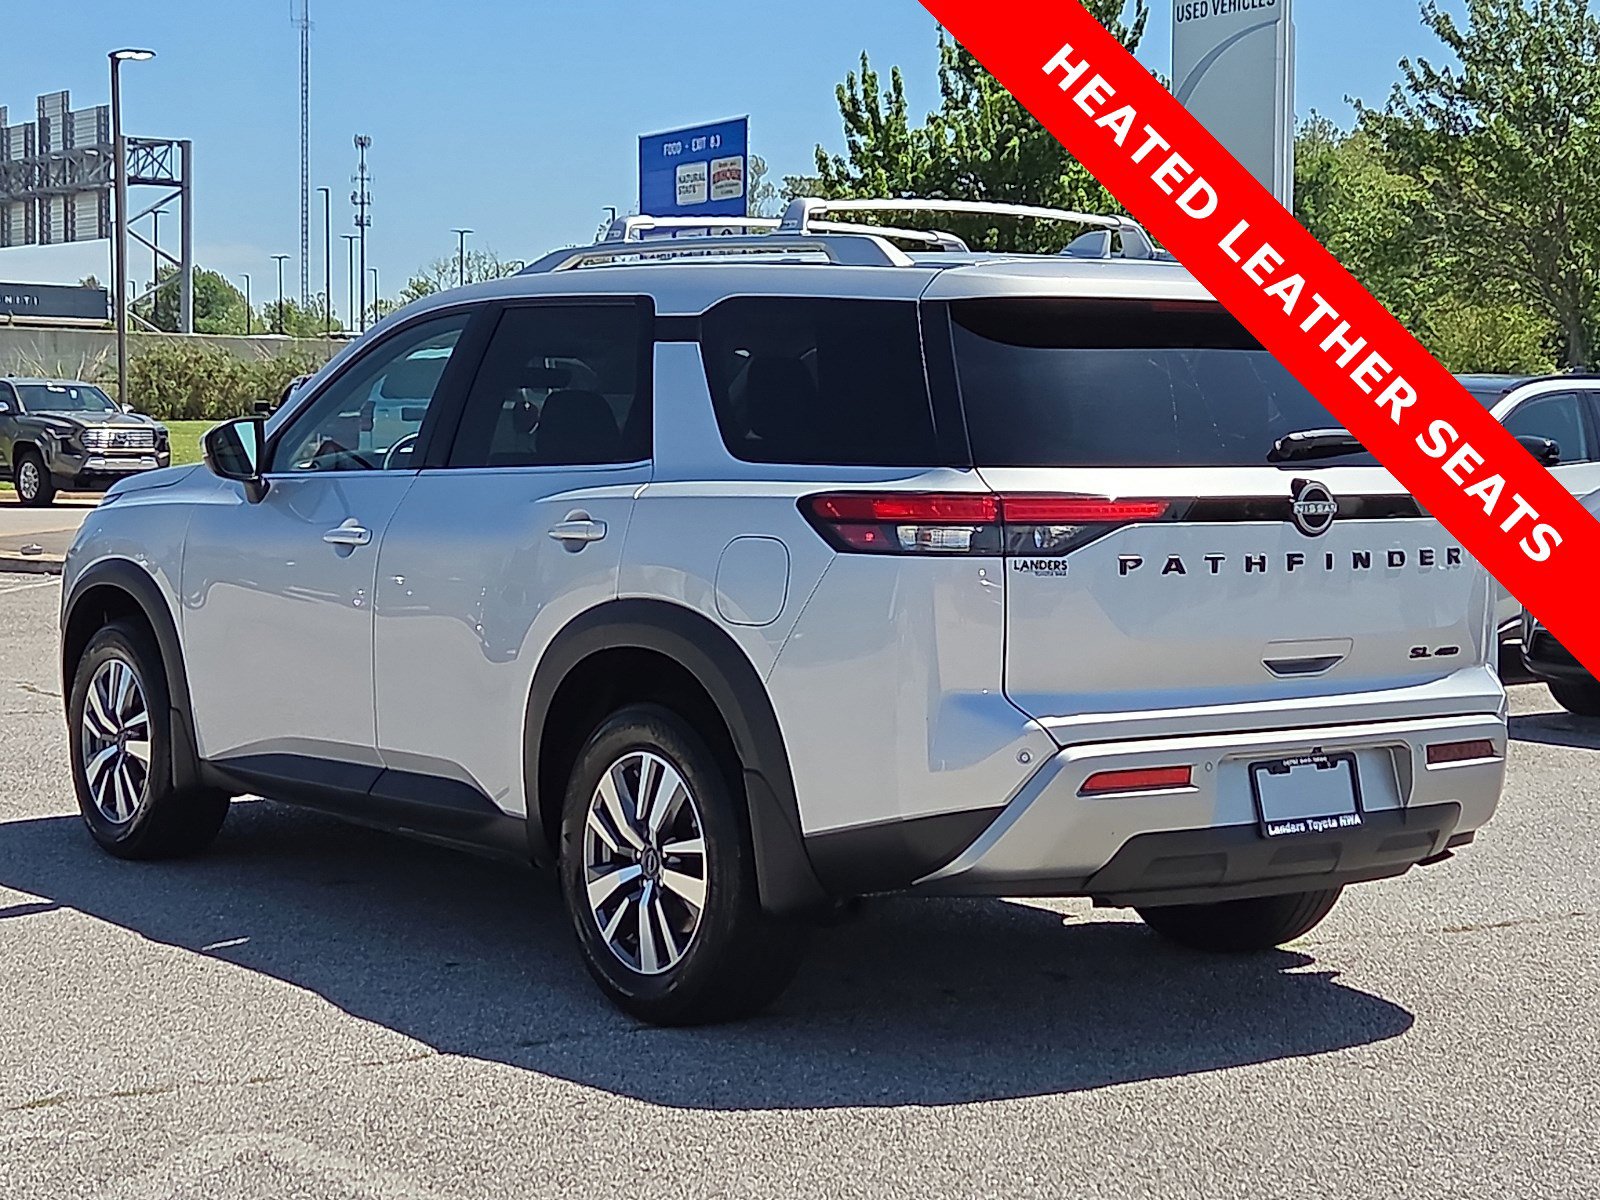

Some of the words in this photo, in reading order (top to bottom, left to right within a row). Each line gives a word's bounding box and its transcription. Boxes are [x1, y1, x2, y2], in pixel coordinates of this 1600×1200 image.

[1176, 1, 1208, 23] USED
[664, 142, 681, 155] FOOD
[692, 137, 706, 152] EXIT
[0, 296, 38, 306] NITI
[1295, 502, 1337, 514] NISSAN
[1013, 559, 1068, 572] LANDERS
[1118, 546, 1463, 577] PATHFINDER
[1409, 646, 1432, 659] SL
[1307, 819, 1338, 832] Toyota
